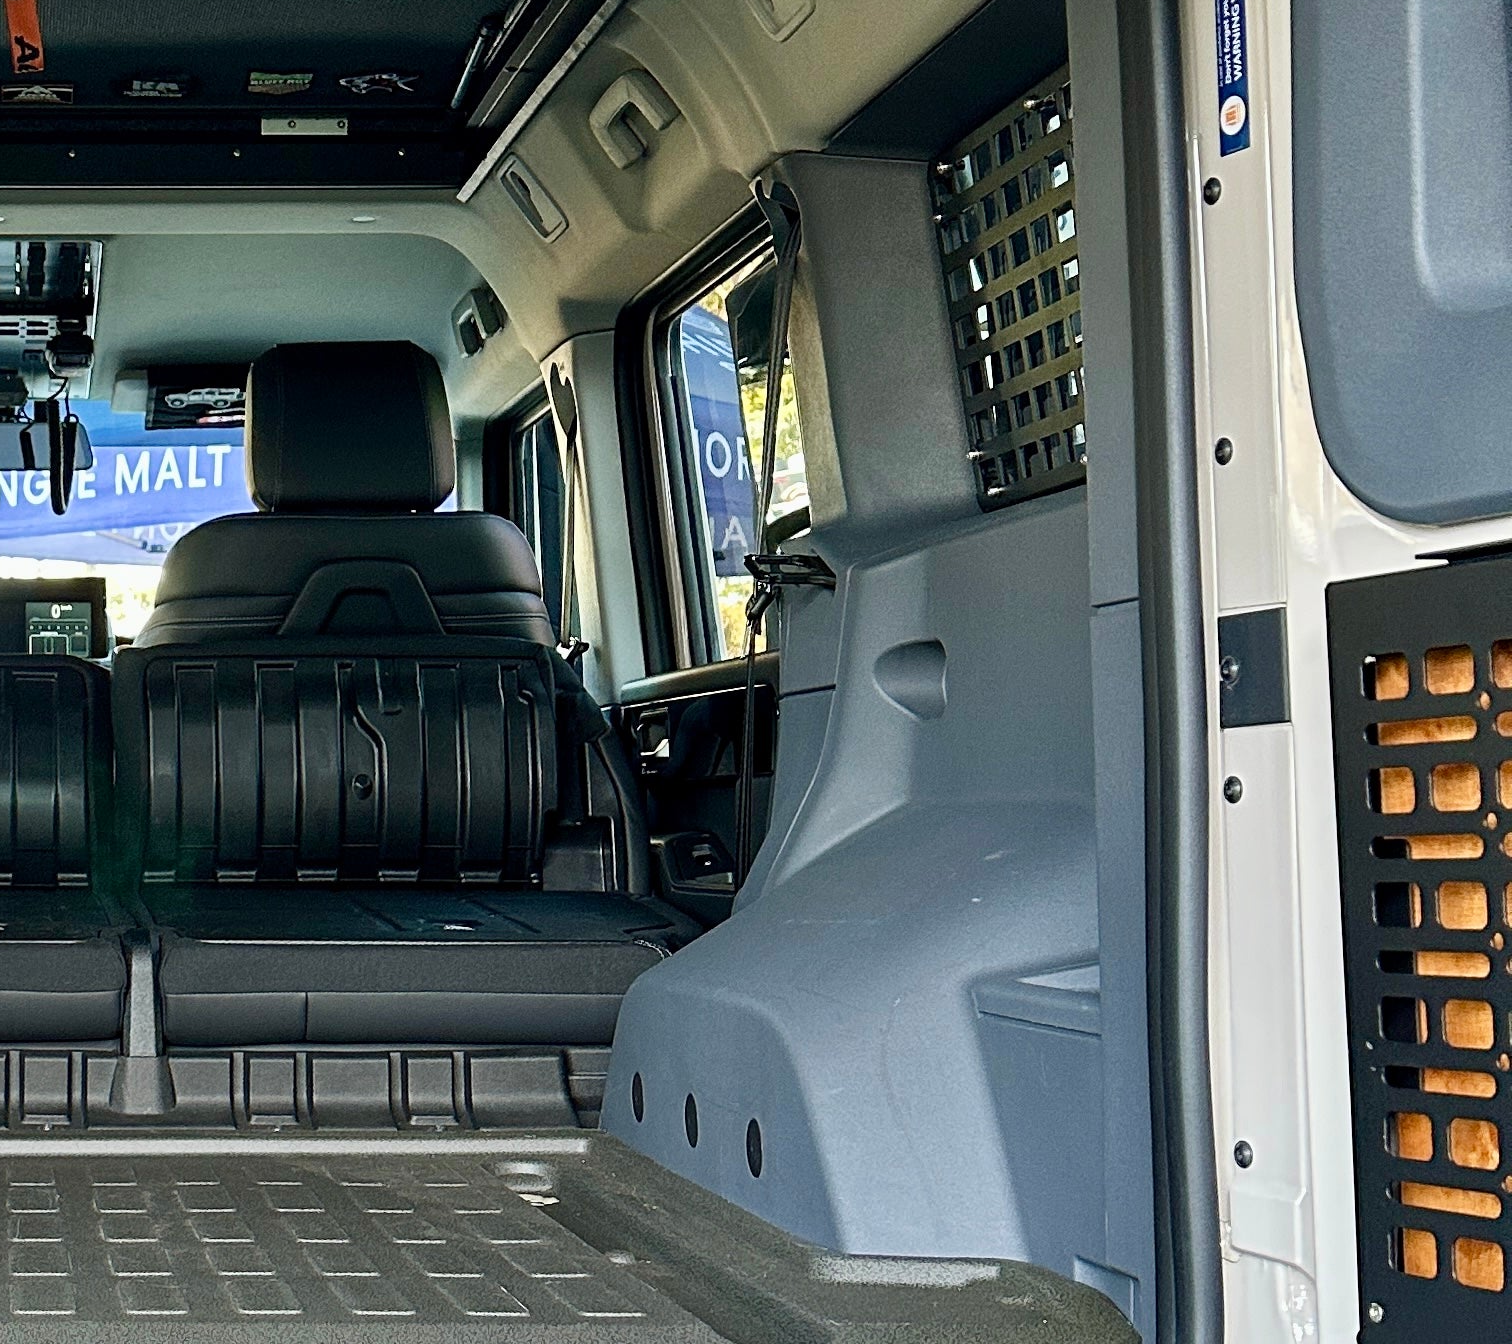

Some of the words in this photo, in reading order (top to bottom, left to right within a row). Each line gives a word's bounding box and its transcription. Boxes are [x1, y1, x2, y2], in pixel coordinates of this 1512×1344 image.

[1223, 19, 1232, 52] forget
[1231, 3, 1243, 82] WARNING
[114, 444, 232, 496] MALT
